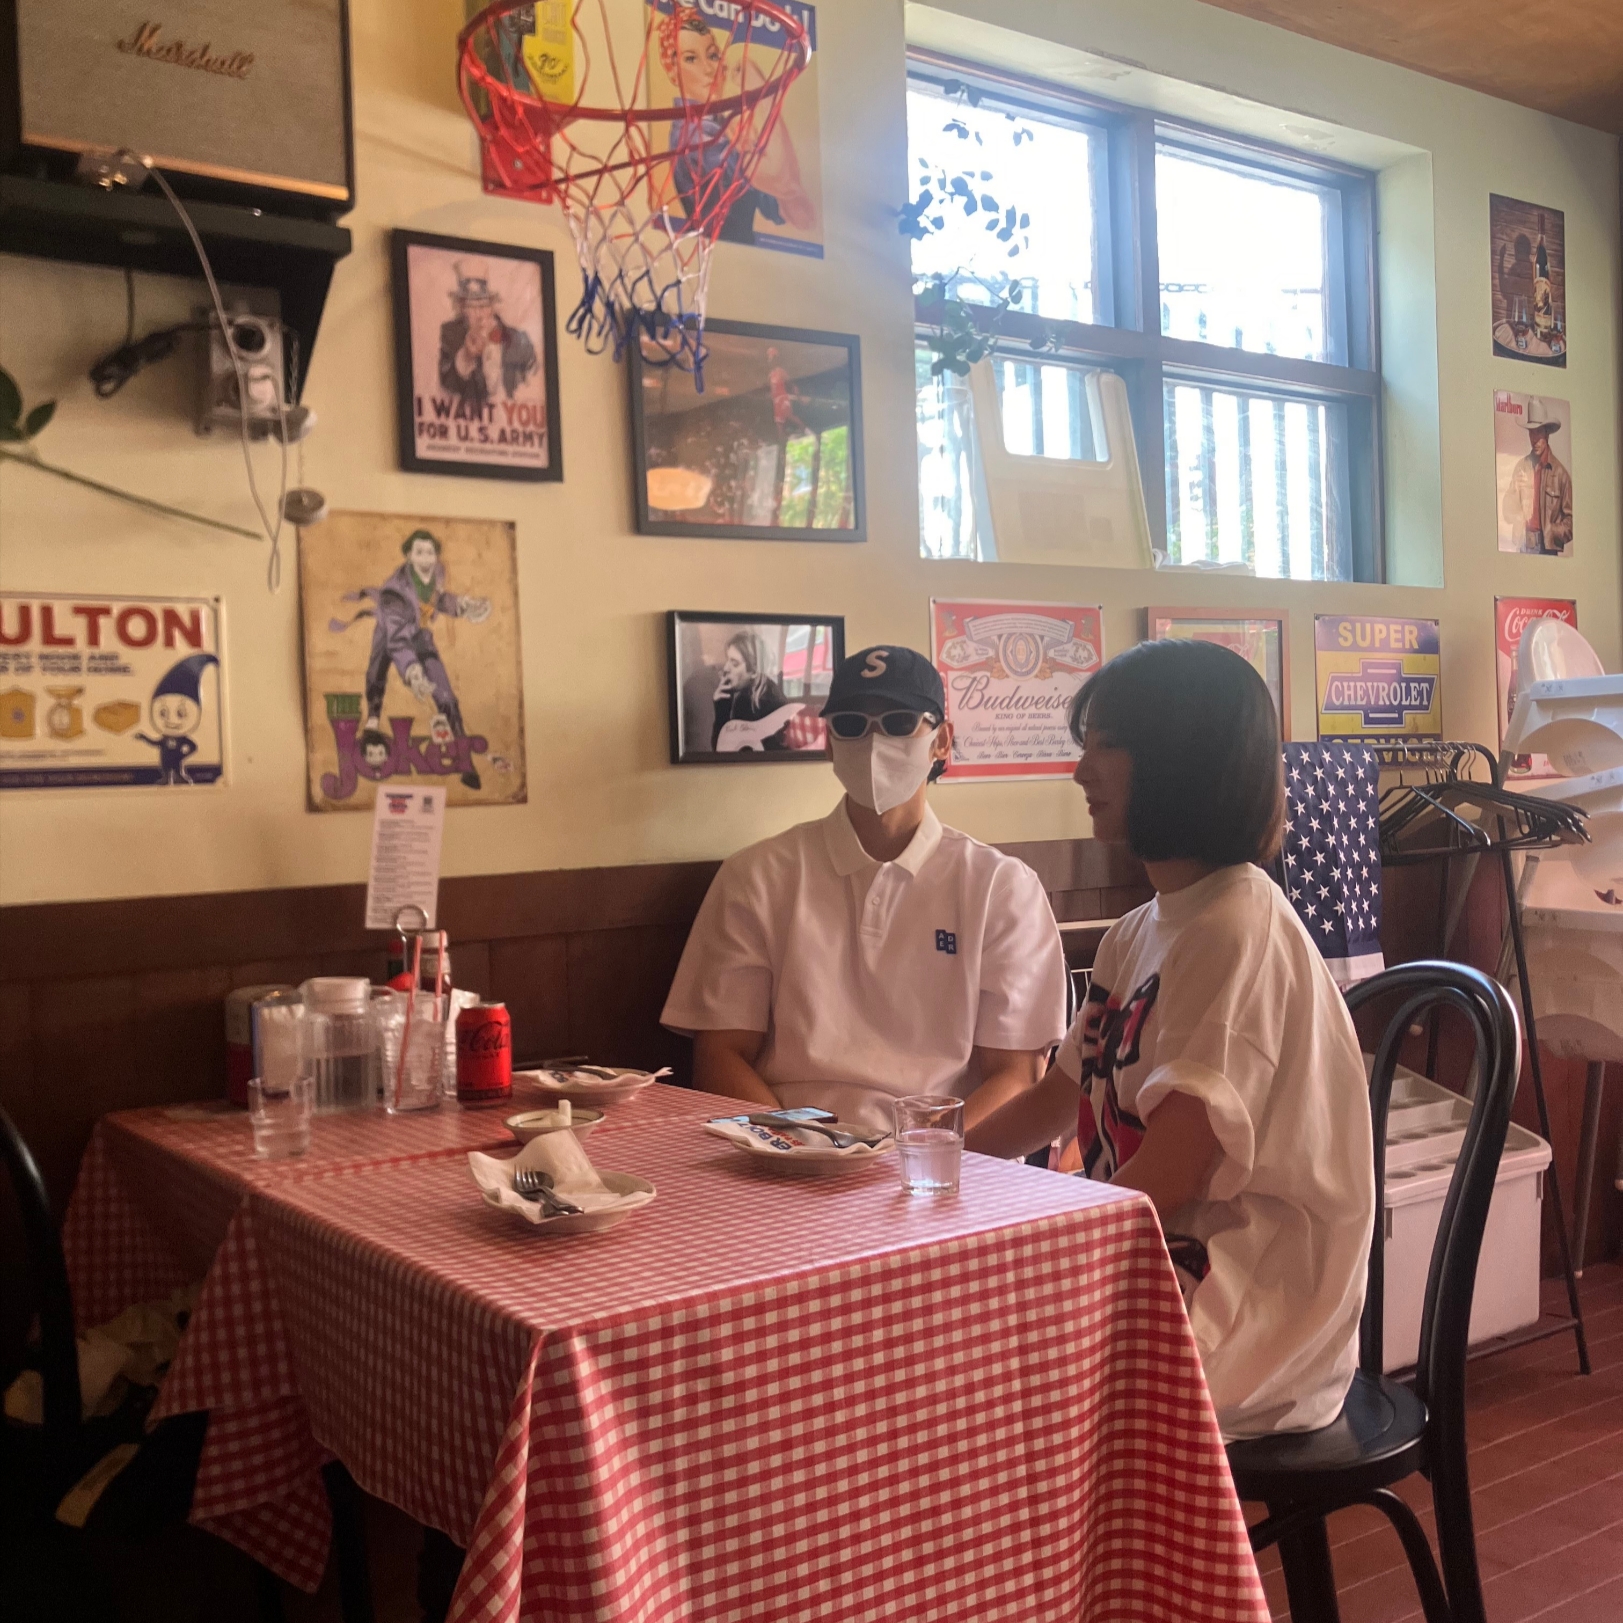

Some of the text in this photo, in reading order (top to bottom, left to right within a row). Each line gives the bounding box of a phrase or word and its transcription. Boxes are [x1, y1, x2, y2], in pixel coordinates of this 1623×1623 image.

[117, 21, 256, 79] Marshall
[416, 397, 546, 429] I WANT YOU
[417, 421, 448, 439] FOR
[498, 429, 546, 449] ARMY
[1338, 622, 1419, 649] SUPER
[861, 649, 890, 678] S
[951, 674, 1073, 712] Budweise
[1331, 681, 1429, 705] CHEVROLET
